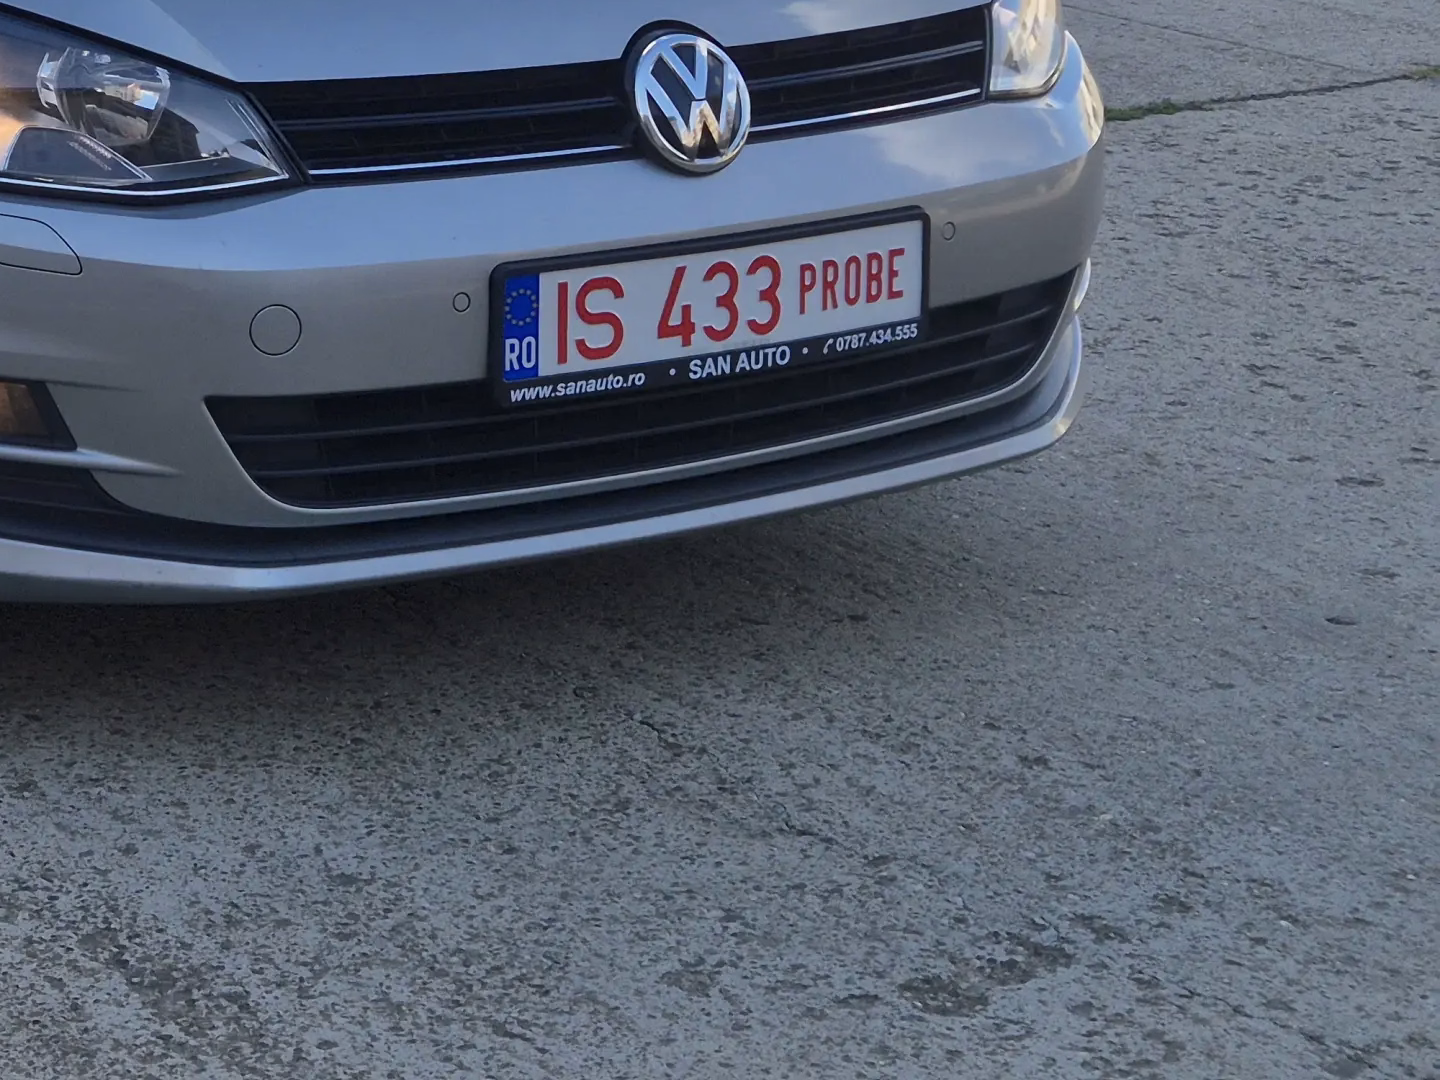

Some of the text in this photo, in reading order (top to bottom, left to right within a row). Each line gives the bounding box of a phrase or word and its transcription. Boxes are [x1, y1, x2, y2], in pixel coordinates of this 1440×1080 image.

[557, 247, 906, 366] IS 433 PROBE
[504, 336, 536, 372] RO
[510, 323, 918, 403] www.sanauto.ro SAN AUTO 0787.434.555
